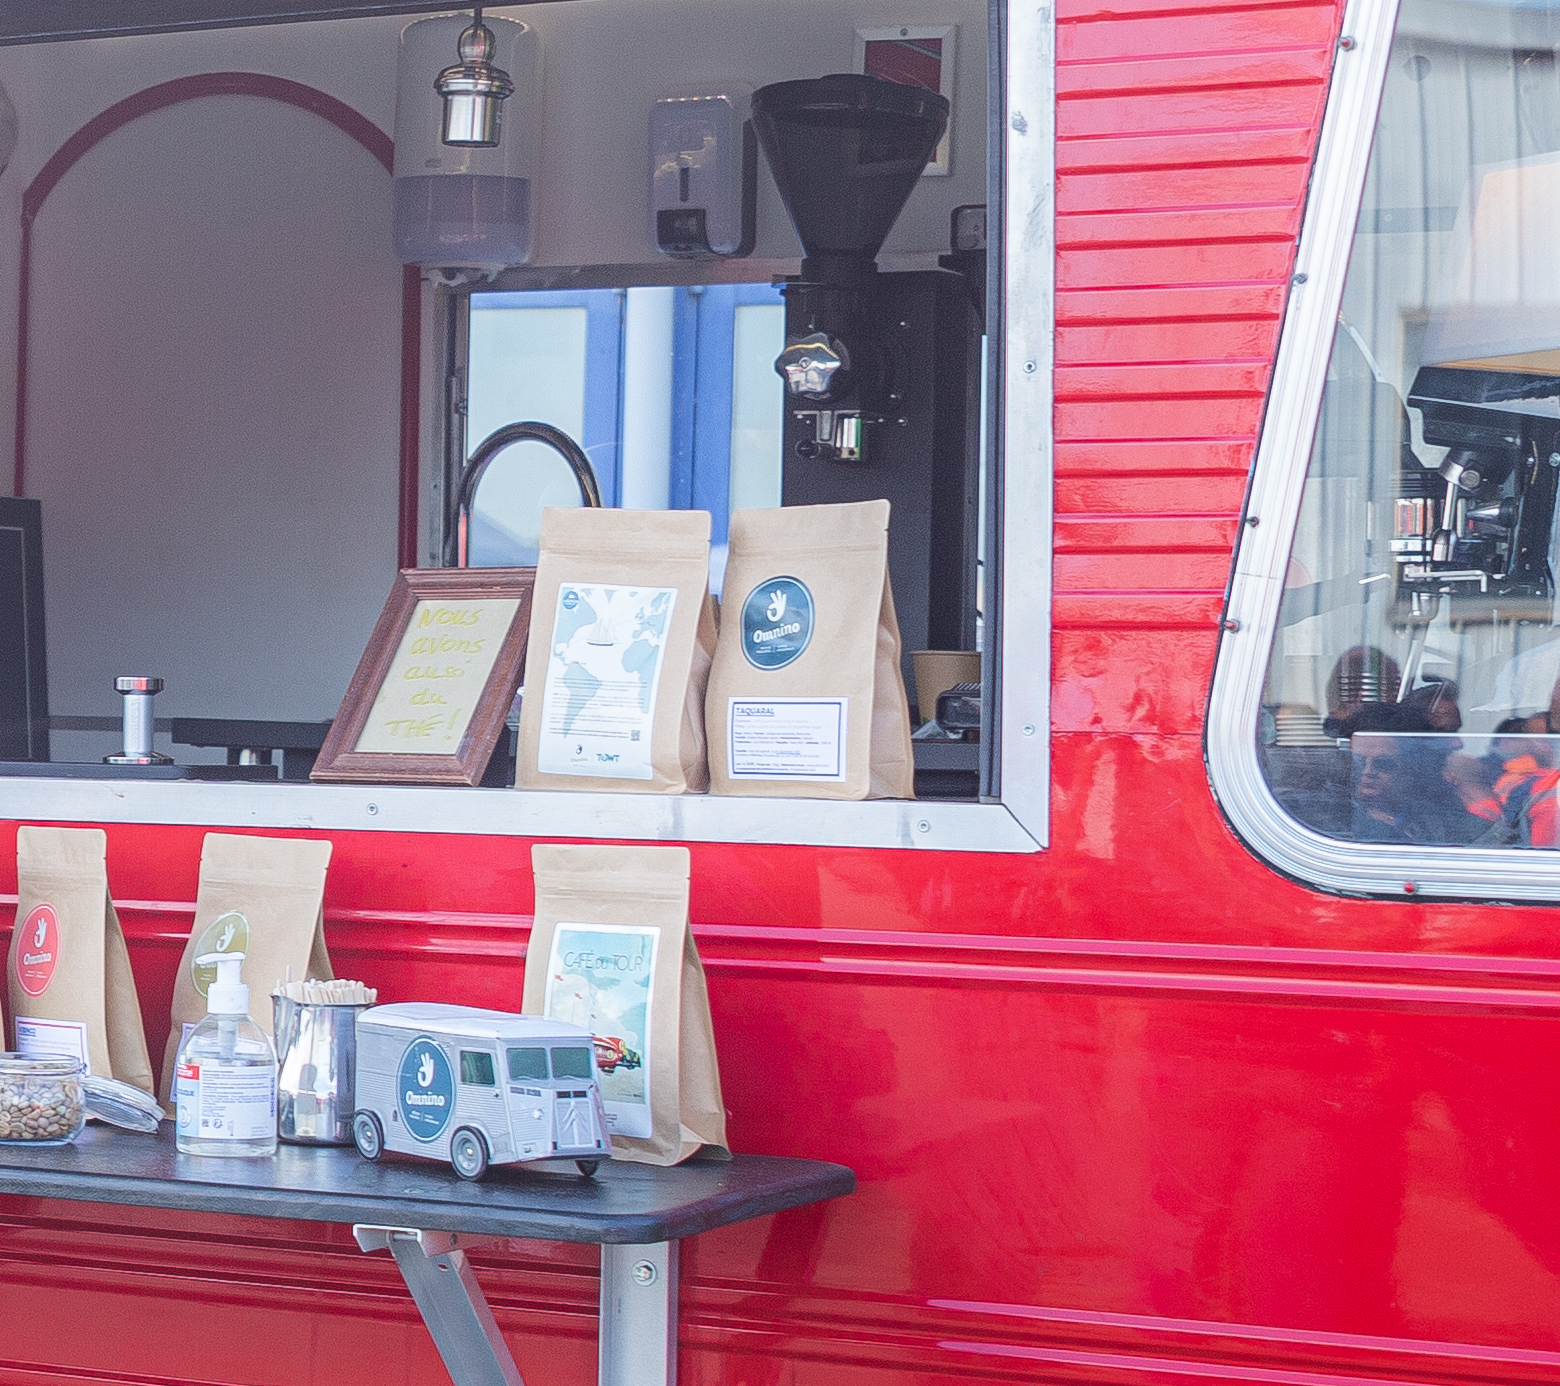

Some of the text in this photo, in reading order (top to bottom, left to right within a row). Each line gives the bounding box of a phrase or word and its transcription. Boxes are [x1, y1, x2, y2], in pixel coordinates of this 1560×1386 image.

[753, 623, 801, 644] Omnino
[410, 688, 447, 706] du
[736, 707, 775, 716] TAQUARAL
[564, 950, 594, 969] CAFÉ
[612, 954, 643, 971] TOUR
[405, 1090, 446, 1107] Omnino
